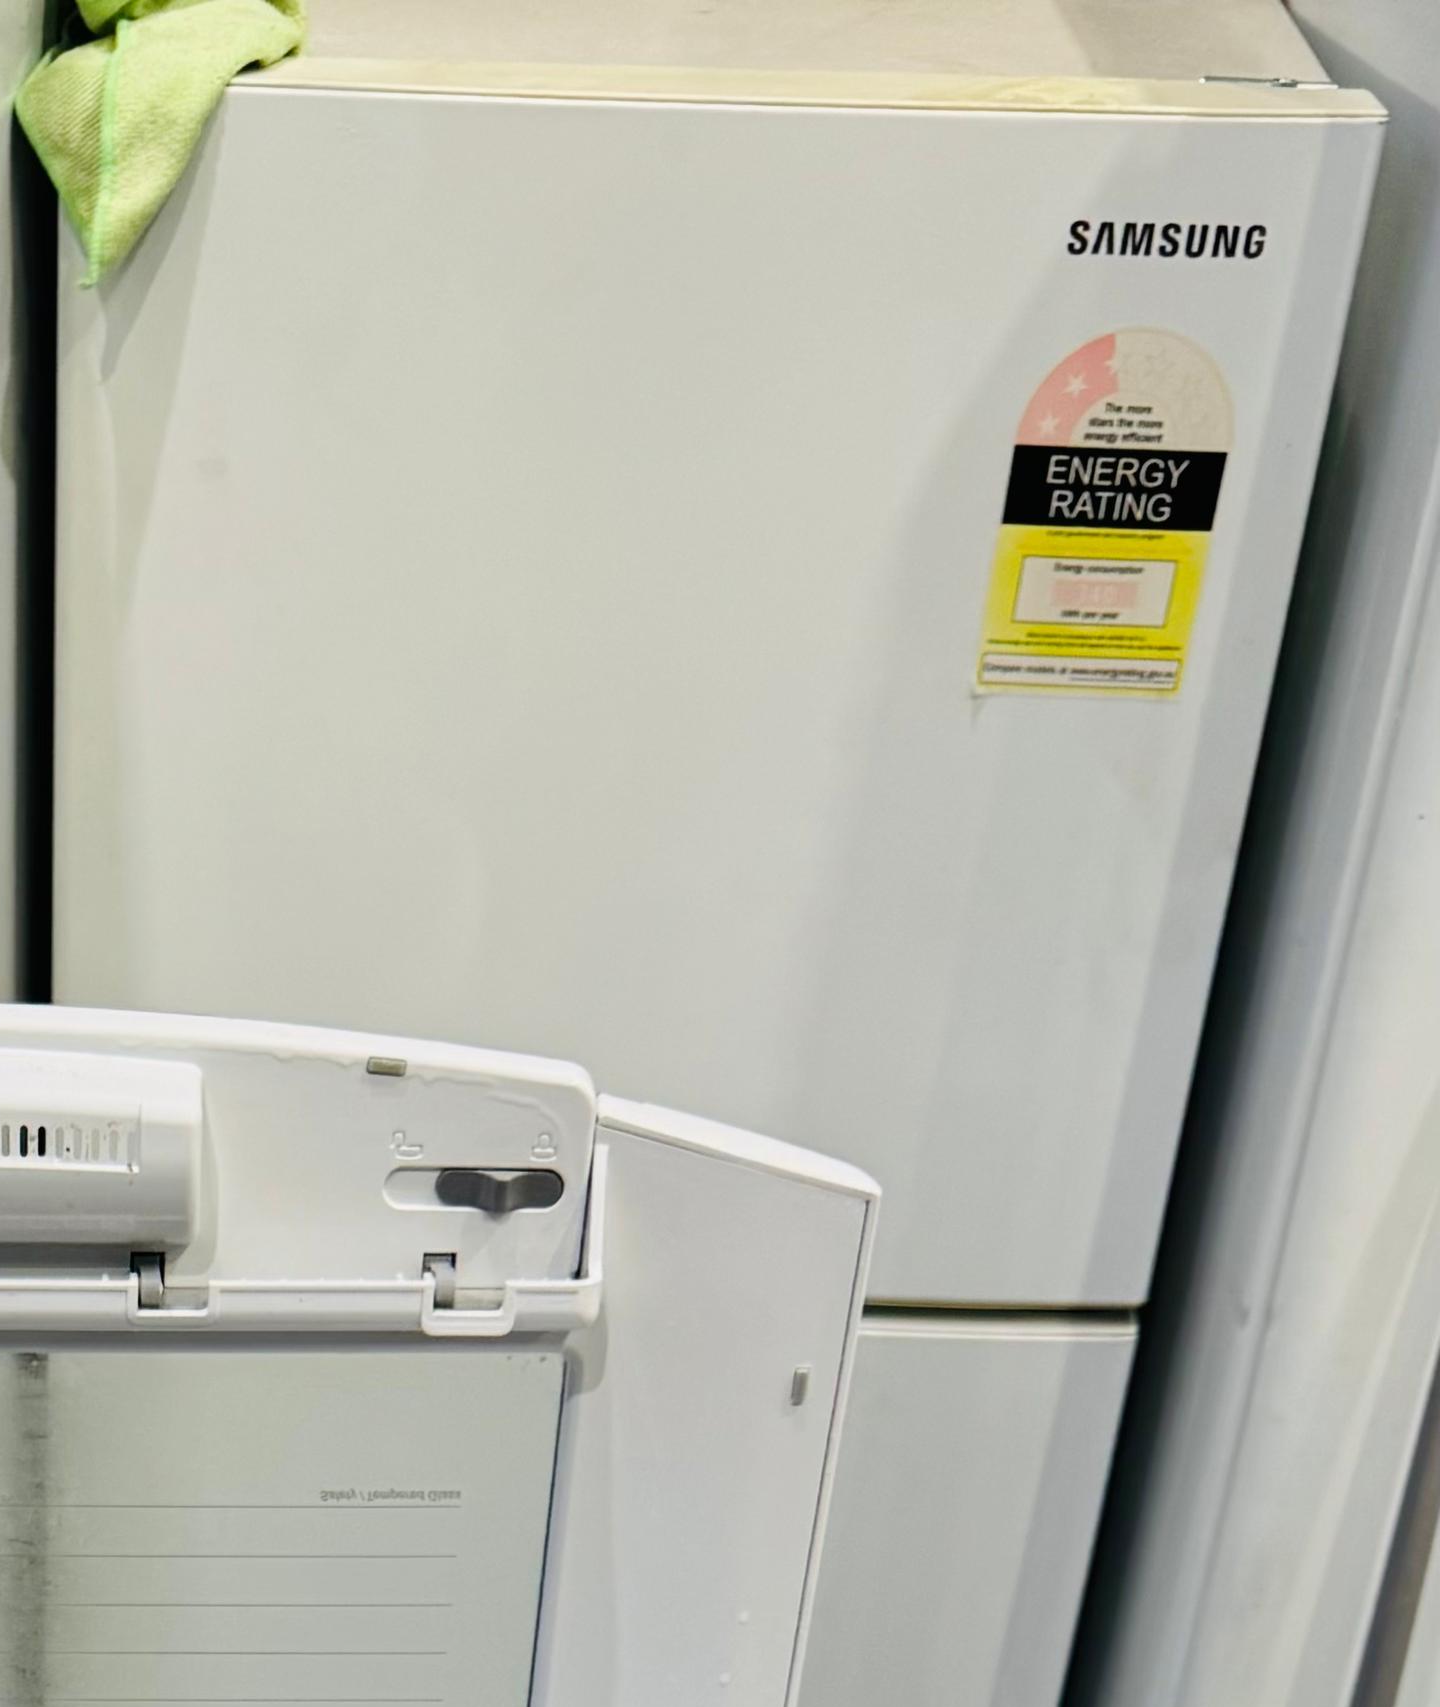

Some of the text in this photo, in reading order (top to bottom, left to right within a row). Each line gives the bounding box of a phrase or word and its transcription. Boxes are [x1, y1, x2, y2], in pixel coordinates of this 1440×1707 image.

[1067, 220, 1267, 260] SAMSUNG
[1045, 454, 1190, 489] ENERGY
[1049, 489, 1173, 523] RATING
